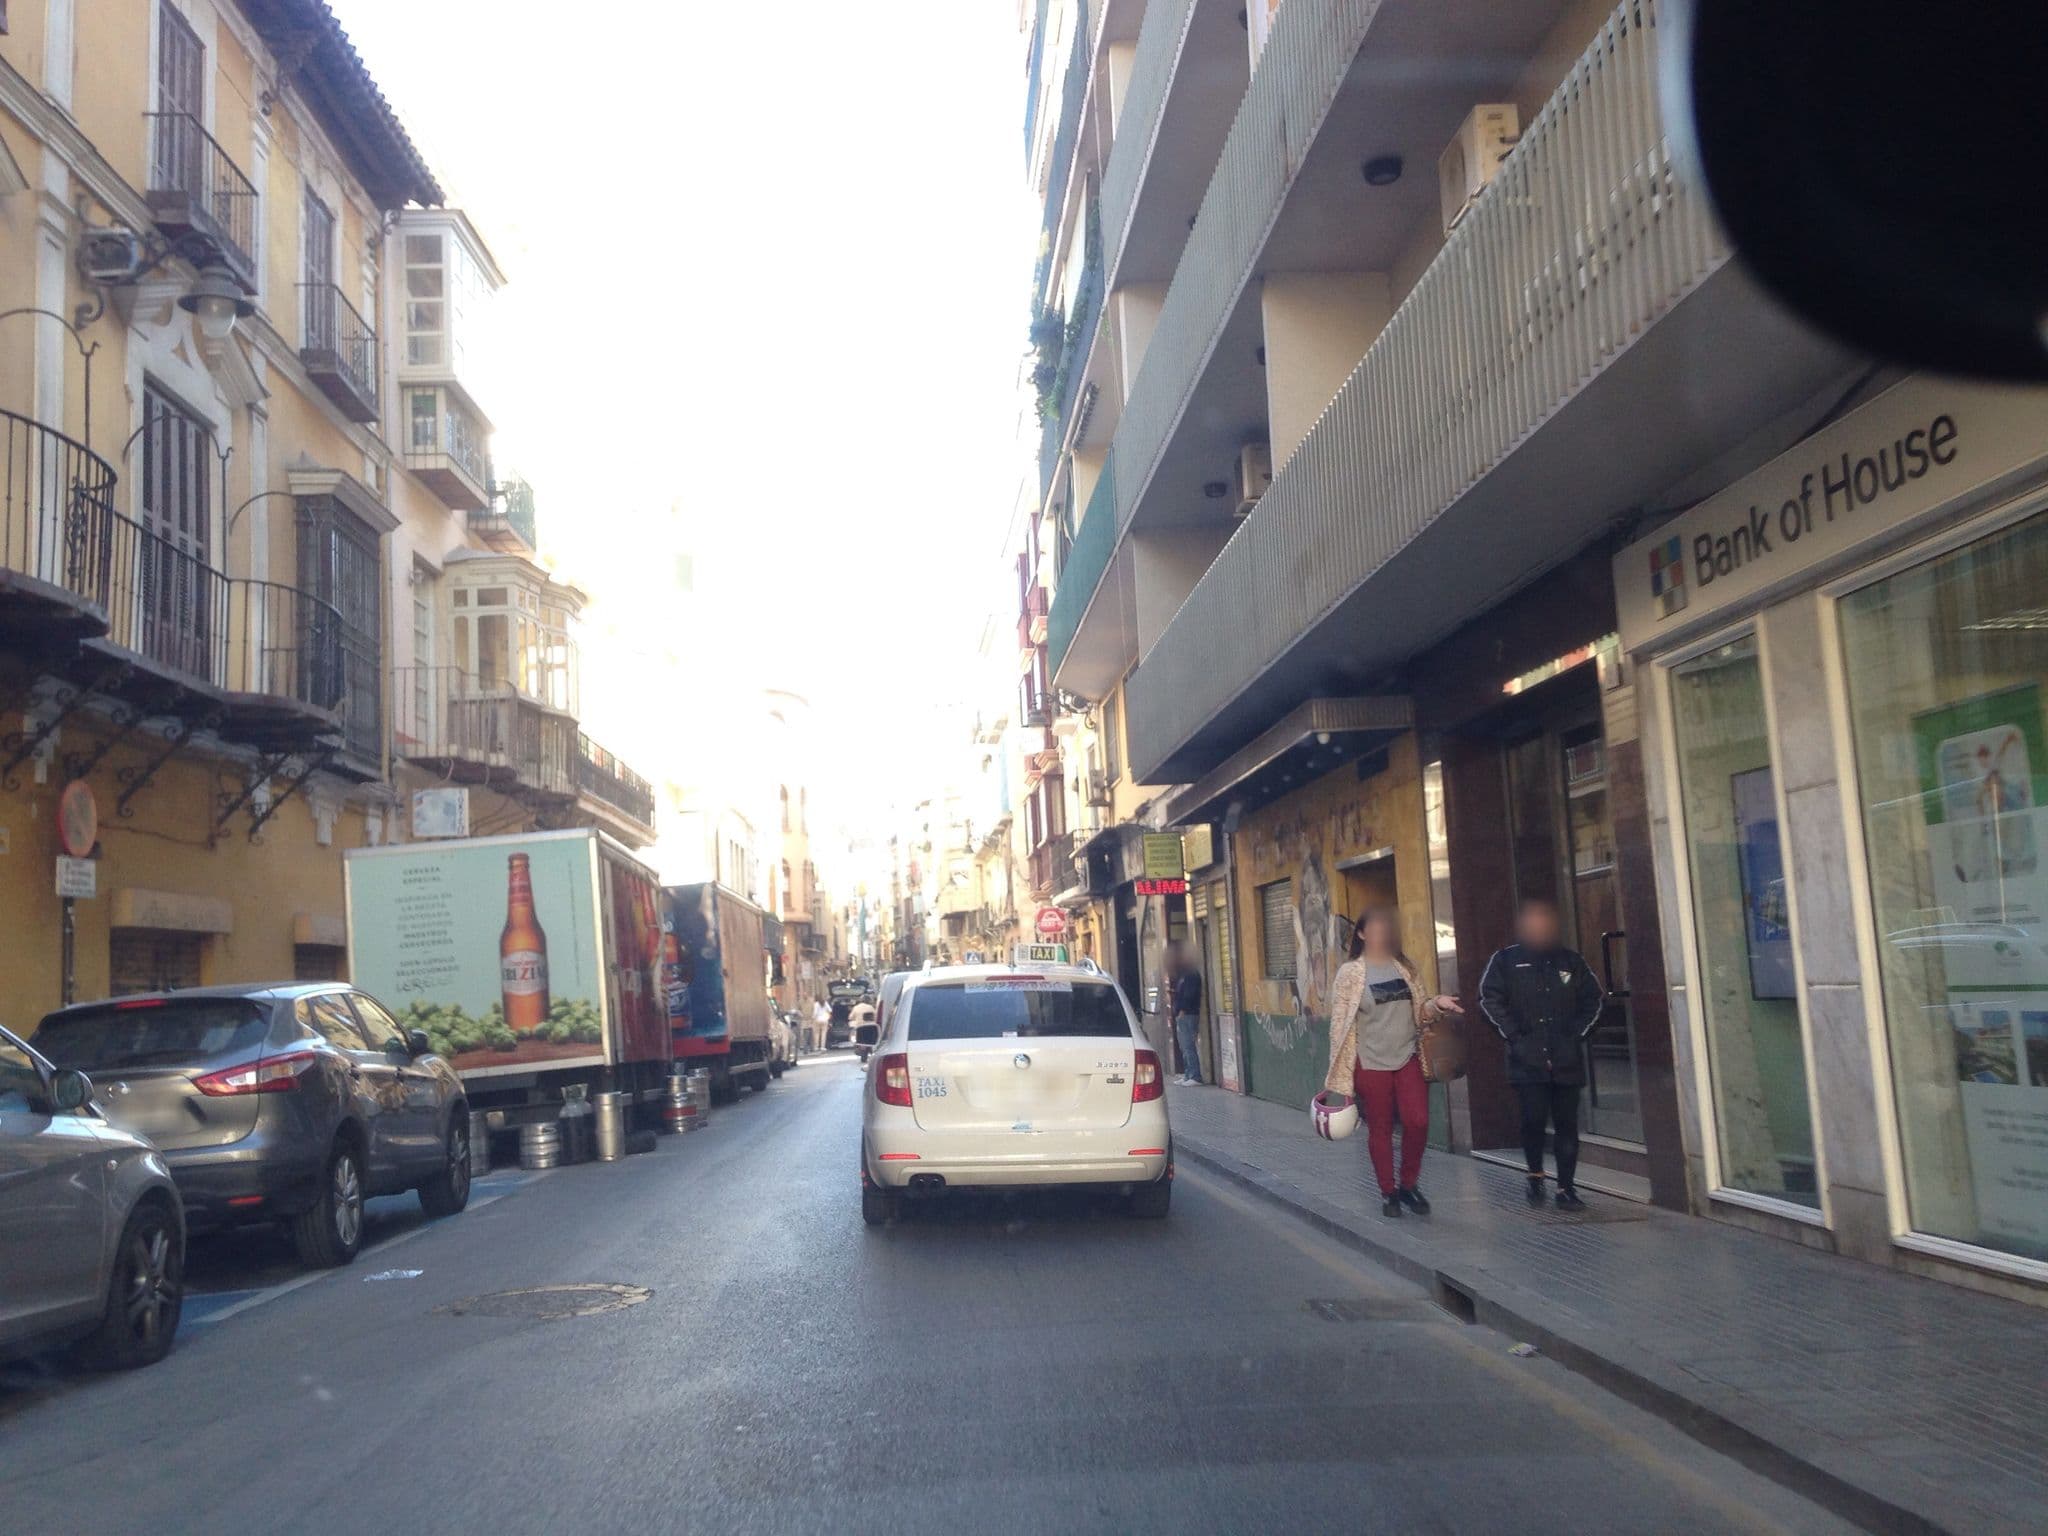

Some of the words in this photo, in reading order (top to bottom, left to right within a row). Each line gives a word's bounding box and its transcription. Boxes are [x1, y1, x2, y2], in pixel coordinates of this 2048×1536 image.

[1693, 505, 1773, 588] Bank
[1779, 472, 1814, 544] of
[1821, 413, 1958, 523] House
[1031, 947, 1055, 960] TAXI
[917, 1076, 945, 1087] TAXI
[918, 1086, 947, 1098] 1045
